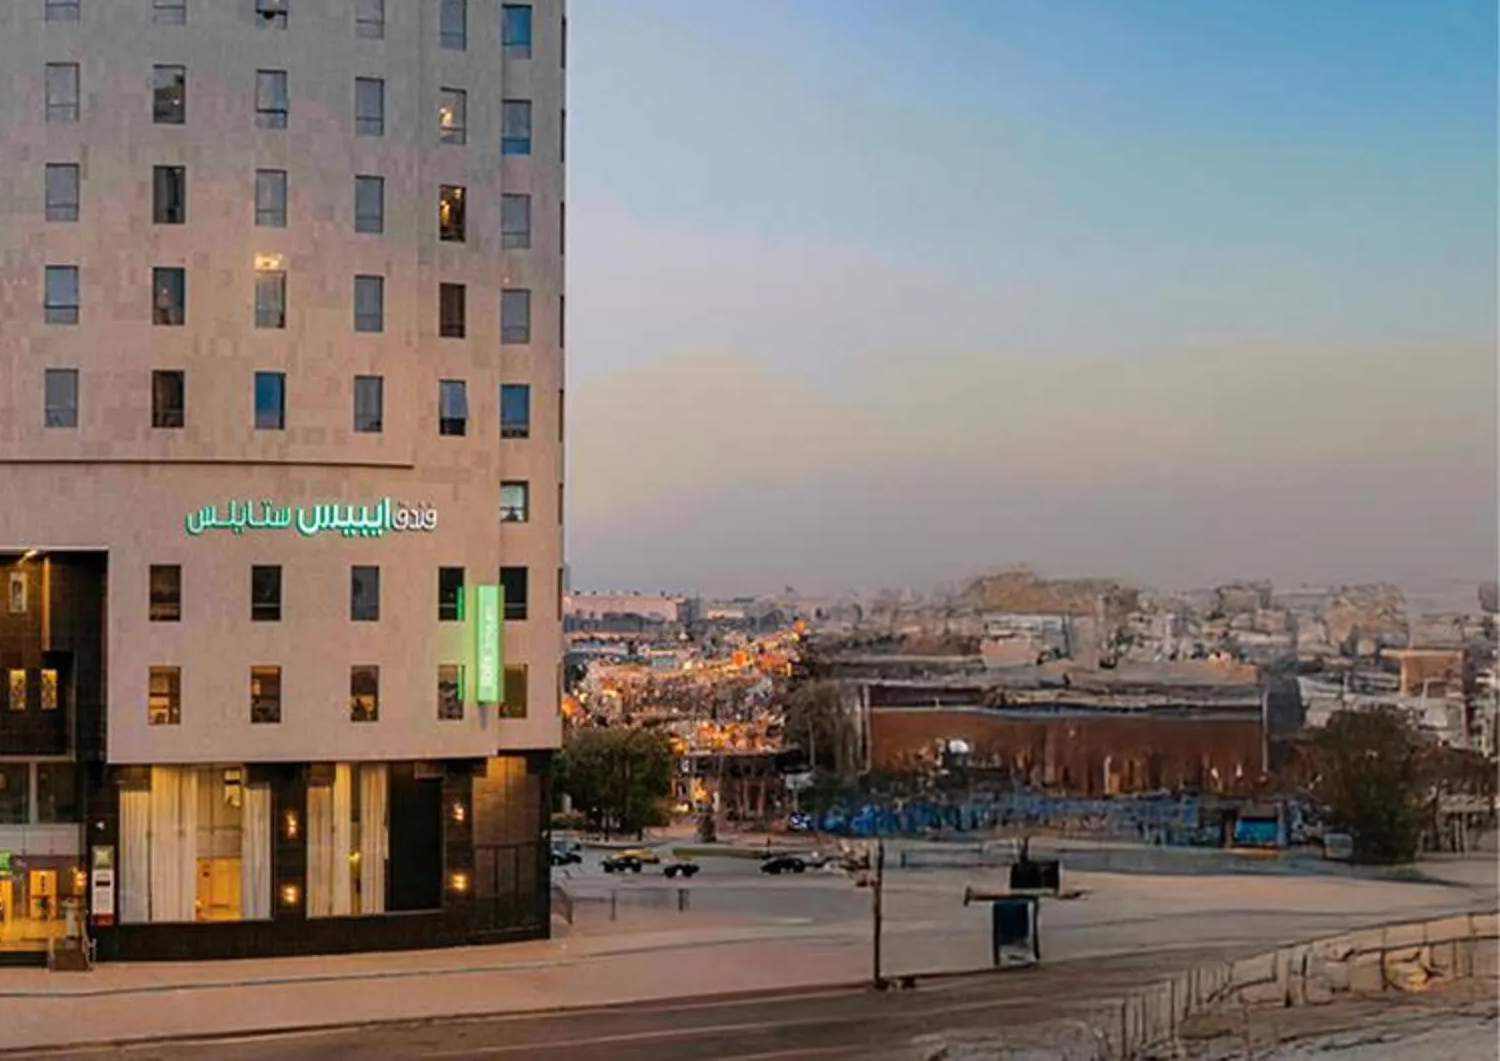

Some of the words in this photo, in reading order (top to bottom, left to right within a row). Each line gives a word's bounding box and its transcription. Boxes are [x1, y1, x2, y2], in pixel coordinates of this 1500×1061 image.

[187, 499, 291, 535] ستايلس
[297, 496, 391, 537] ايبيس
[392, 502, 438, 531] فندق
